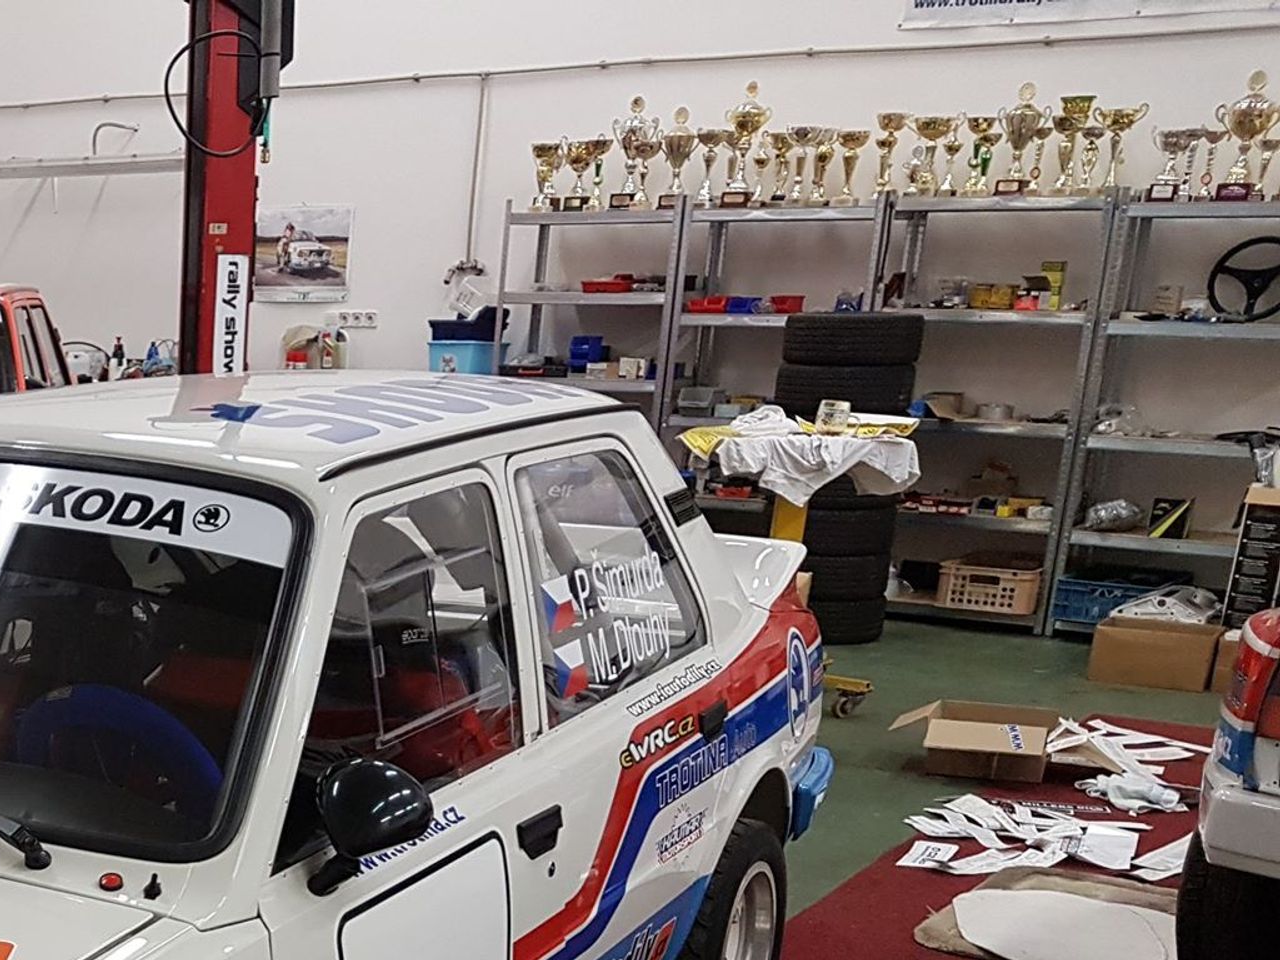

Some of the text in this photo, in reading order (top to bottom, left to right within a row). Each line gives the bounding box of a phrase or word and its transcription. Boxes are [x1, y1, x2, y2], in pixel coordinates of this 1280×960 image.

[222, 261, 240, 310] rally
[573, 542, 665, 620] P. Šimurda
[587, 627, 618, 684] M.
[620, 714, 695, 768] eWRC.cz
[656, 733, 730, 809] TROTINA
